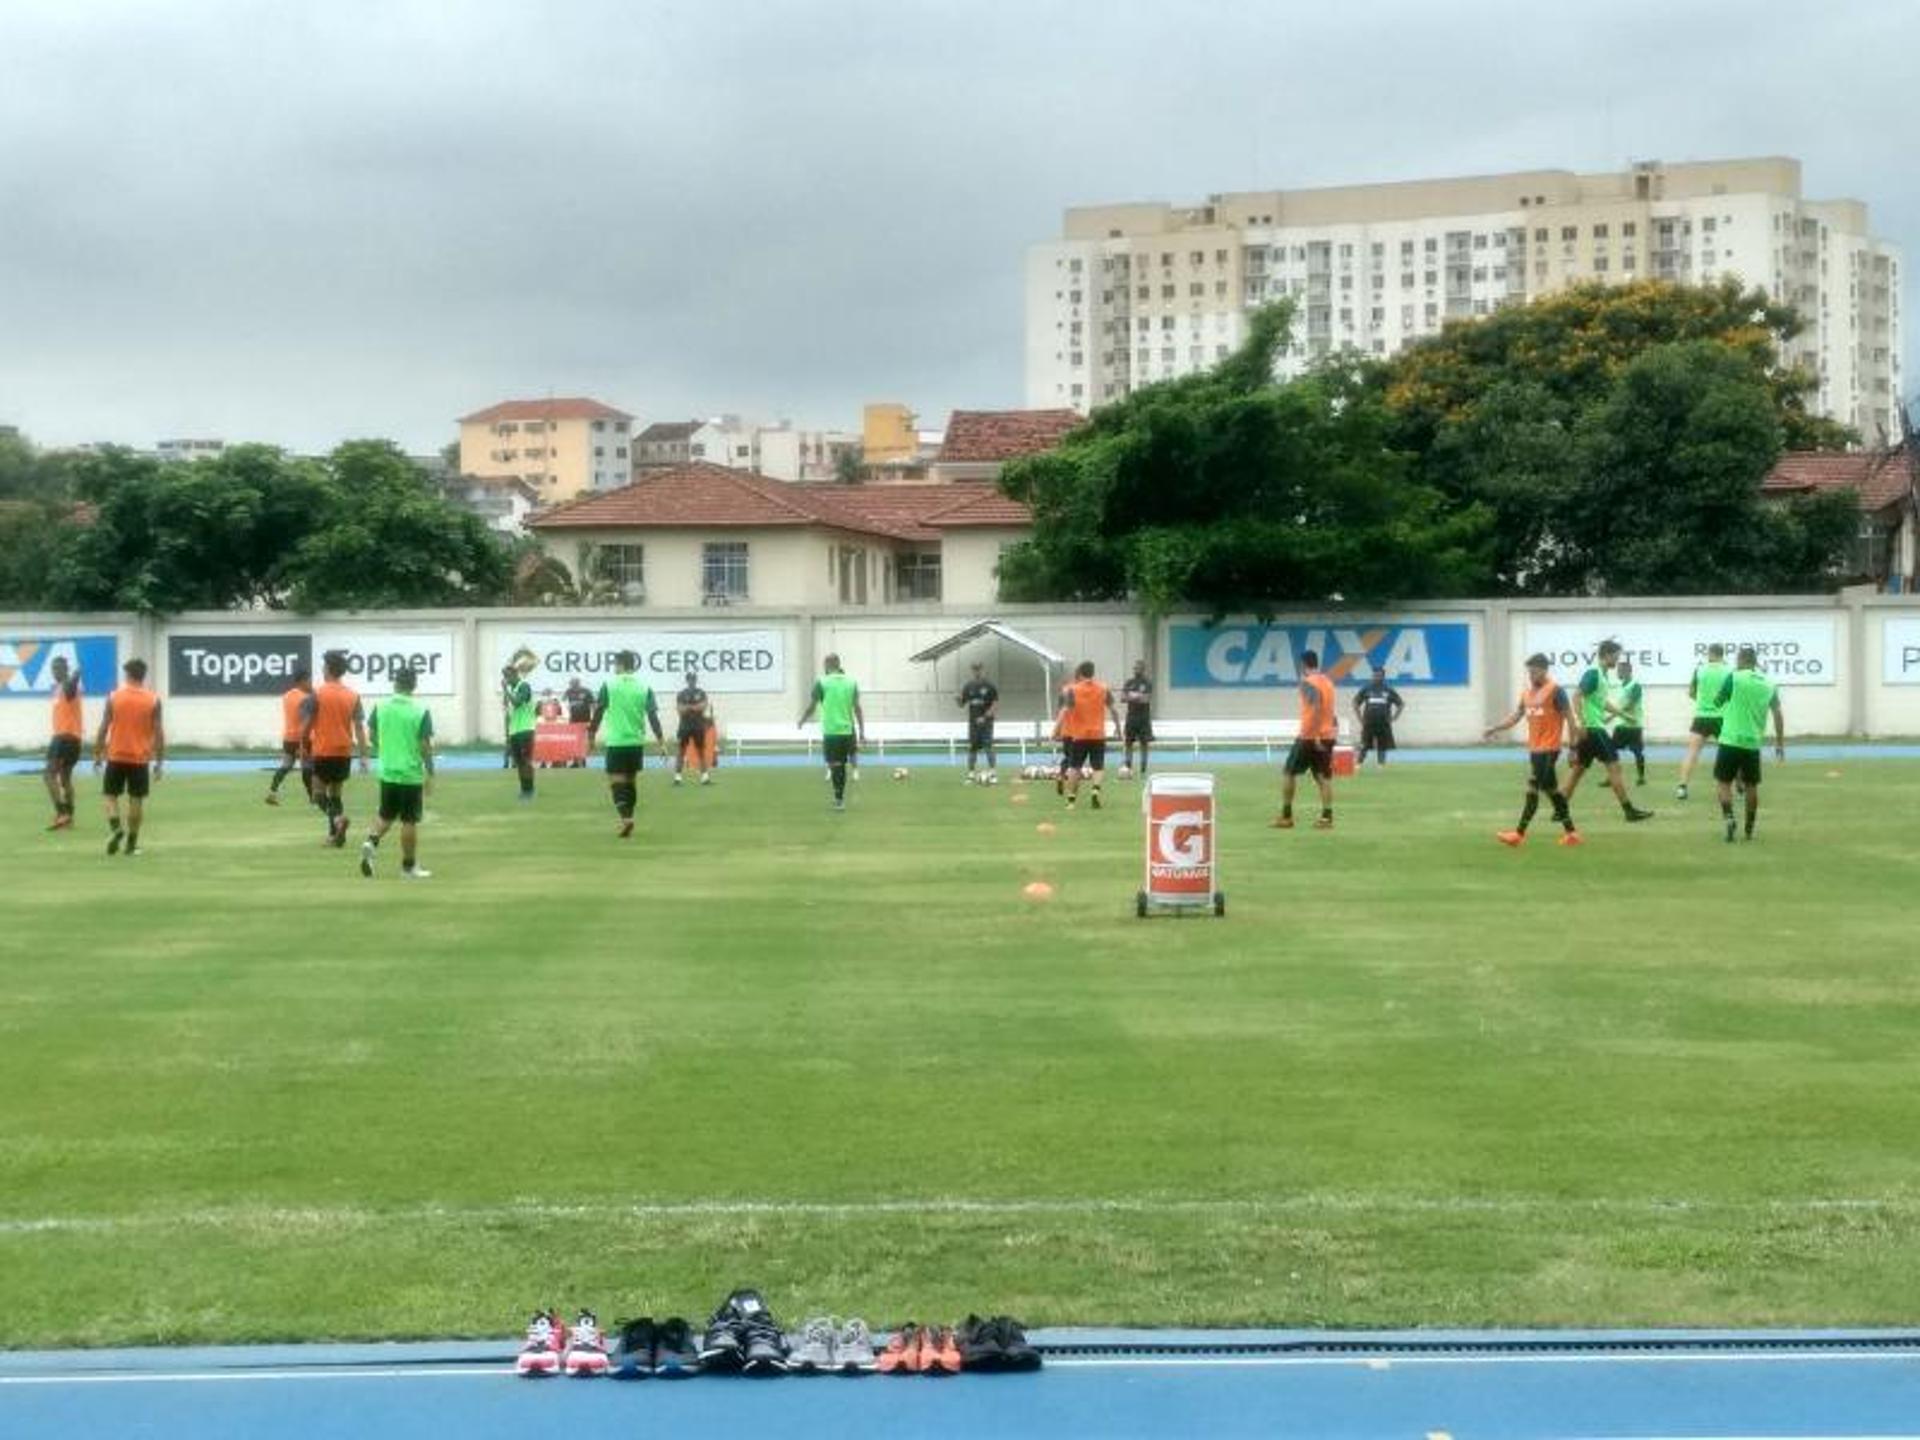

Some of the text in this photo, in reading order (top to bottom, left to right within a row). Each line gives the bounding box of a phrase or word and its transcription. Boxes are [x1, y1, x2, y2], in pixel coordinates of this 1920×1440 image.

[182, 649, 298, 684] Topper
[650, 650, 773, 673] CERCRED
[1206, 630, 1432, 682] CAIXA
[1548, 651, 1671, 666] OVTEL
[1159, 811, 1203, 867] G
